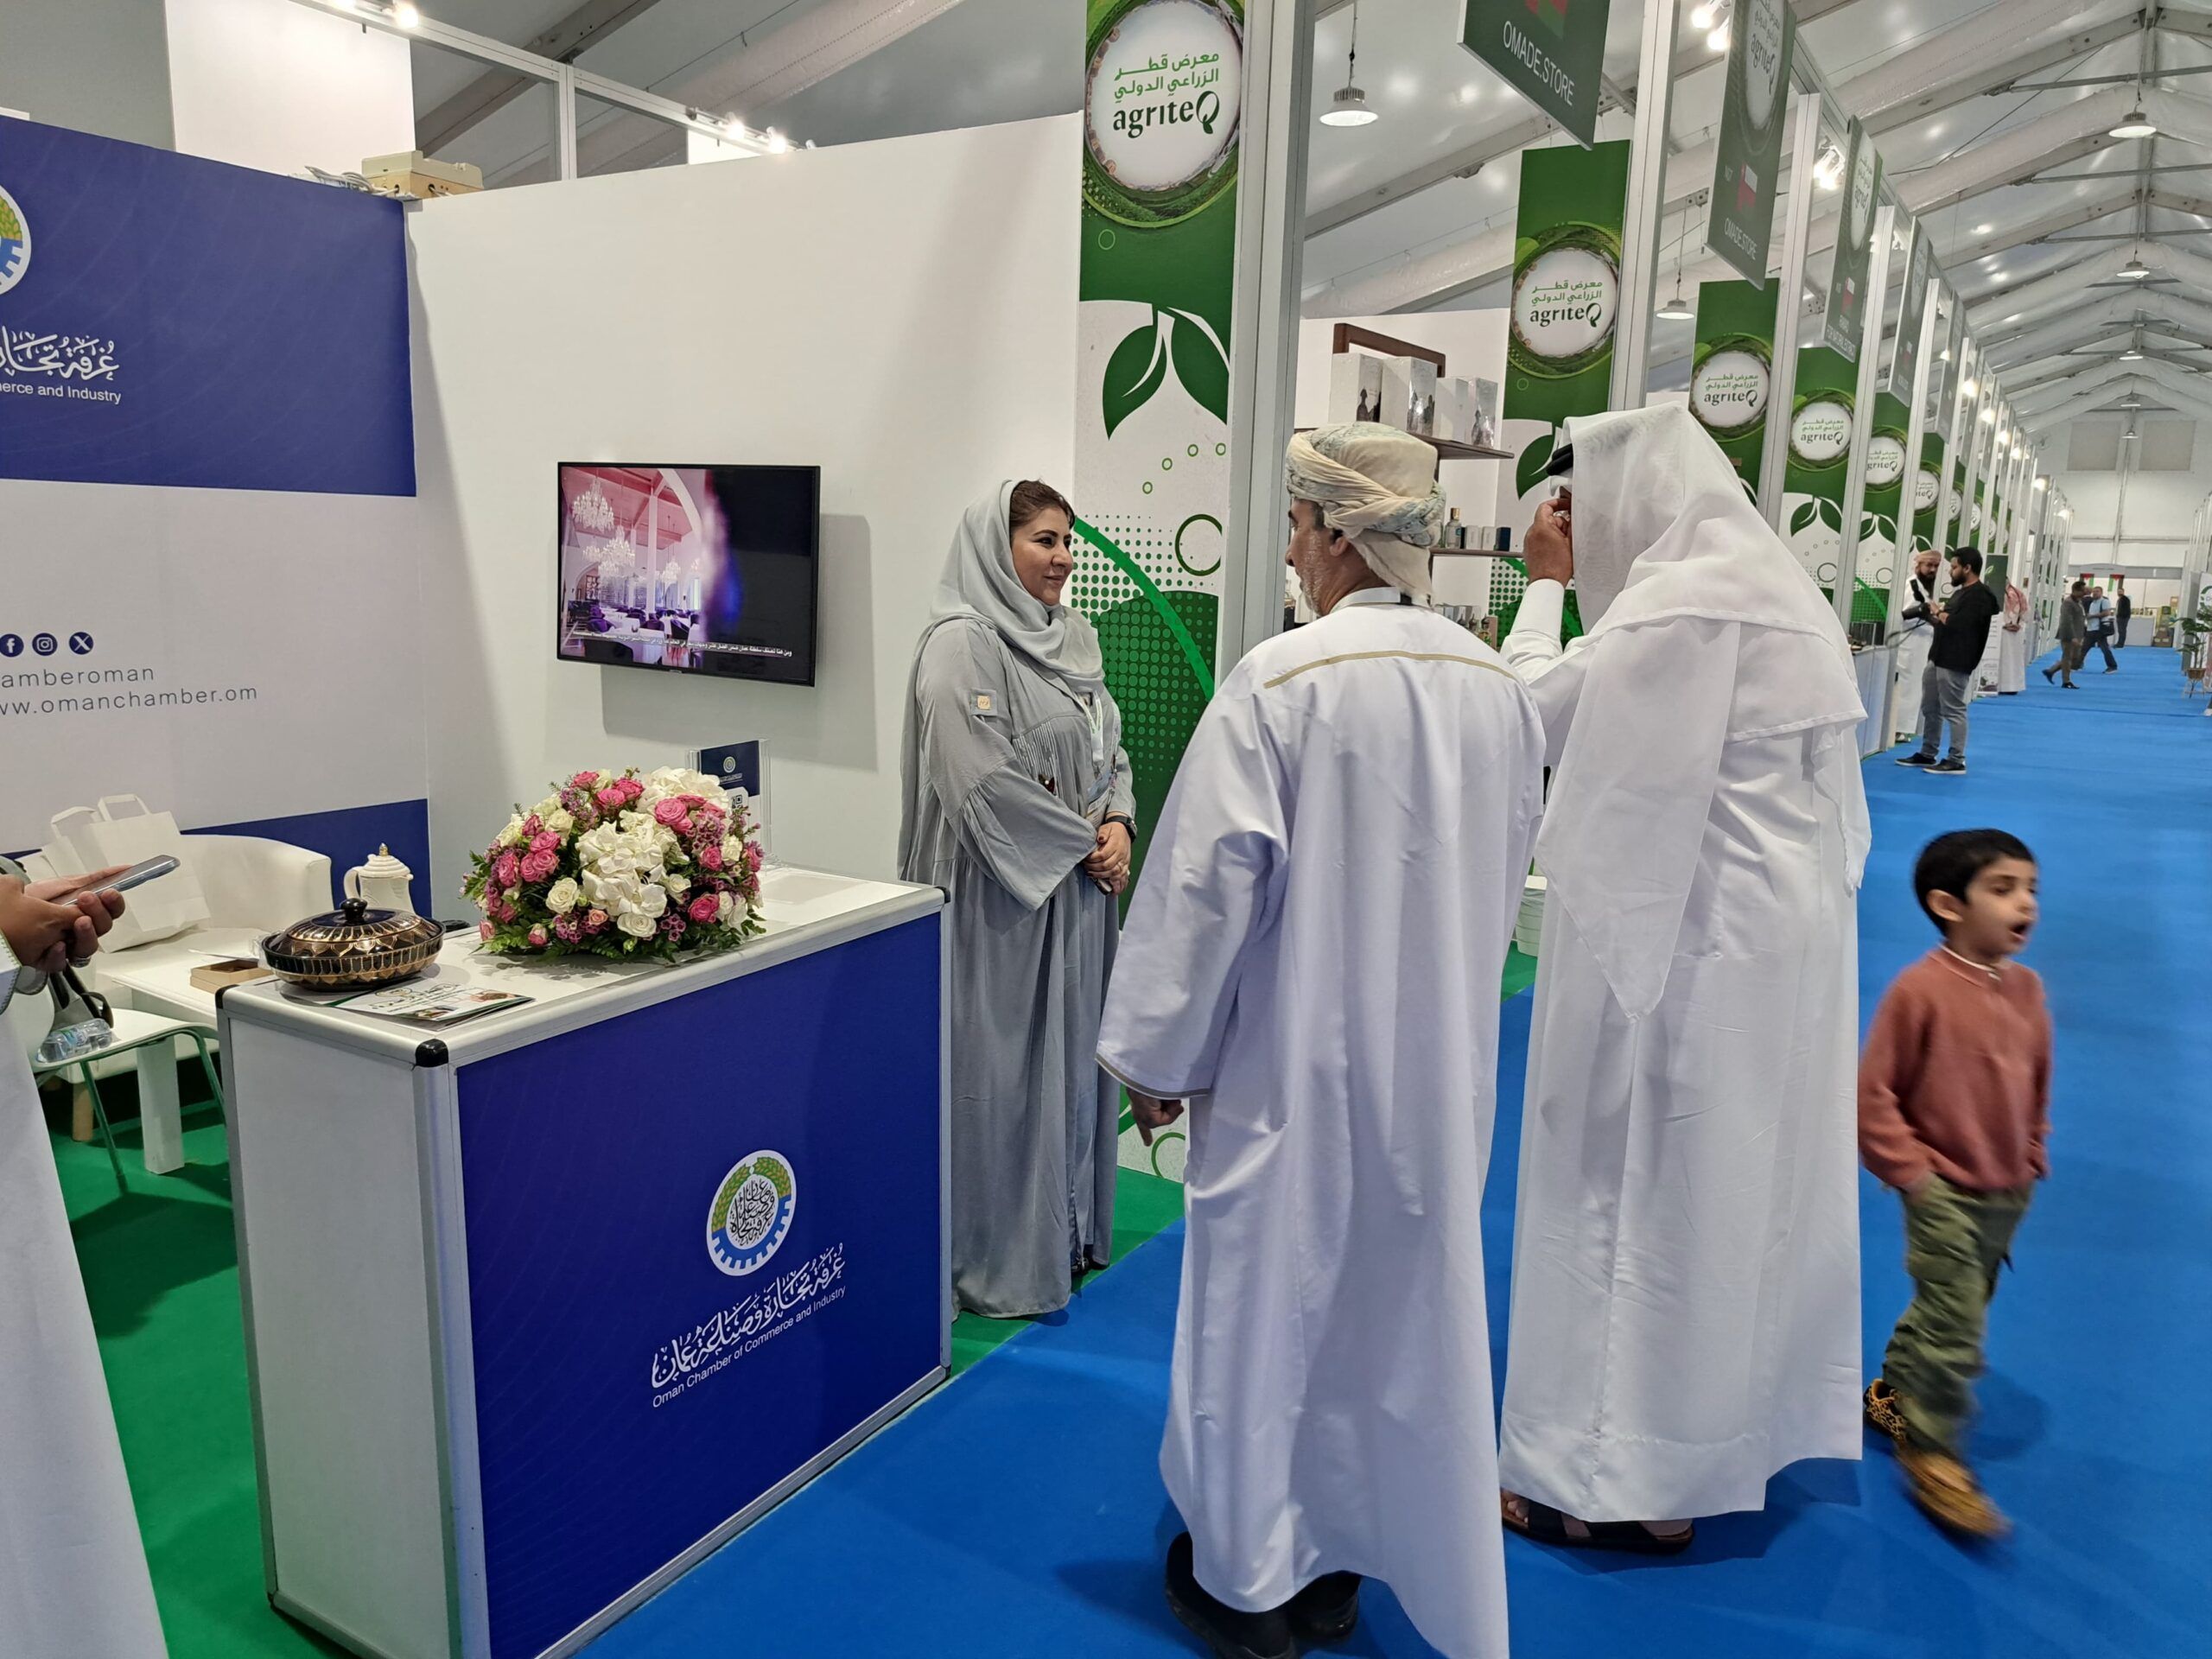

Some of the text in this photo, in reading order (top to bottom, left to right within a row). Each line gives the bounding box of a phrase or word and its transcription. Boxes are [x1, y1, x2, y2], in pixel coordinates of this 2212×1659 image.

[1114, 54, 1219, 81] معرض قطر
[1503, 20, 1575, 106] OMADE.STORE
[1114, 68, 1219, 104] الزراعي الدولي
[1113, 91, 1220, 139] agriteQ
[1571, 281, 1603, 290] معرض
[1531, 290, 1602, 307] الزراعي الدولي
[1529, 302, 1602, 327] agriteQ
[37, 385, 63, 397] and
[68, 386, 121, 404] Industry
[1704, 389, 1758, 407] agriteQ
[1866, 461, 1897, 472] griteQ
[652, 1286, 846, 1408] Oman Chamber of Commerce and Industry
